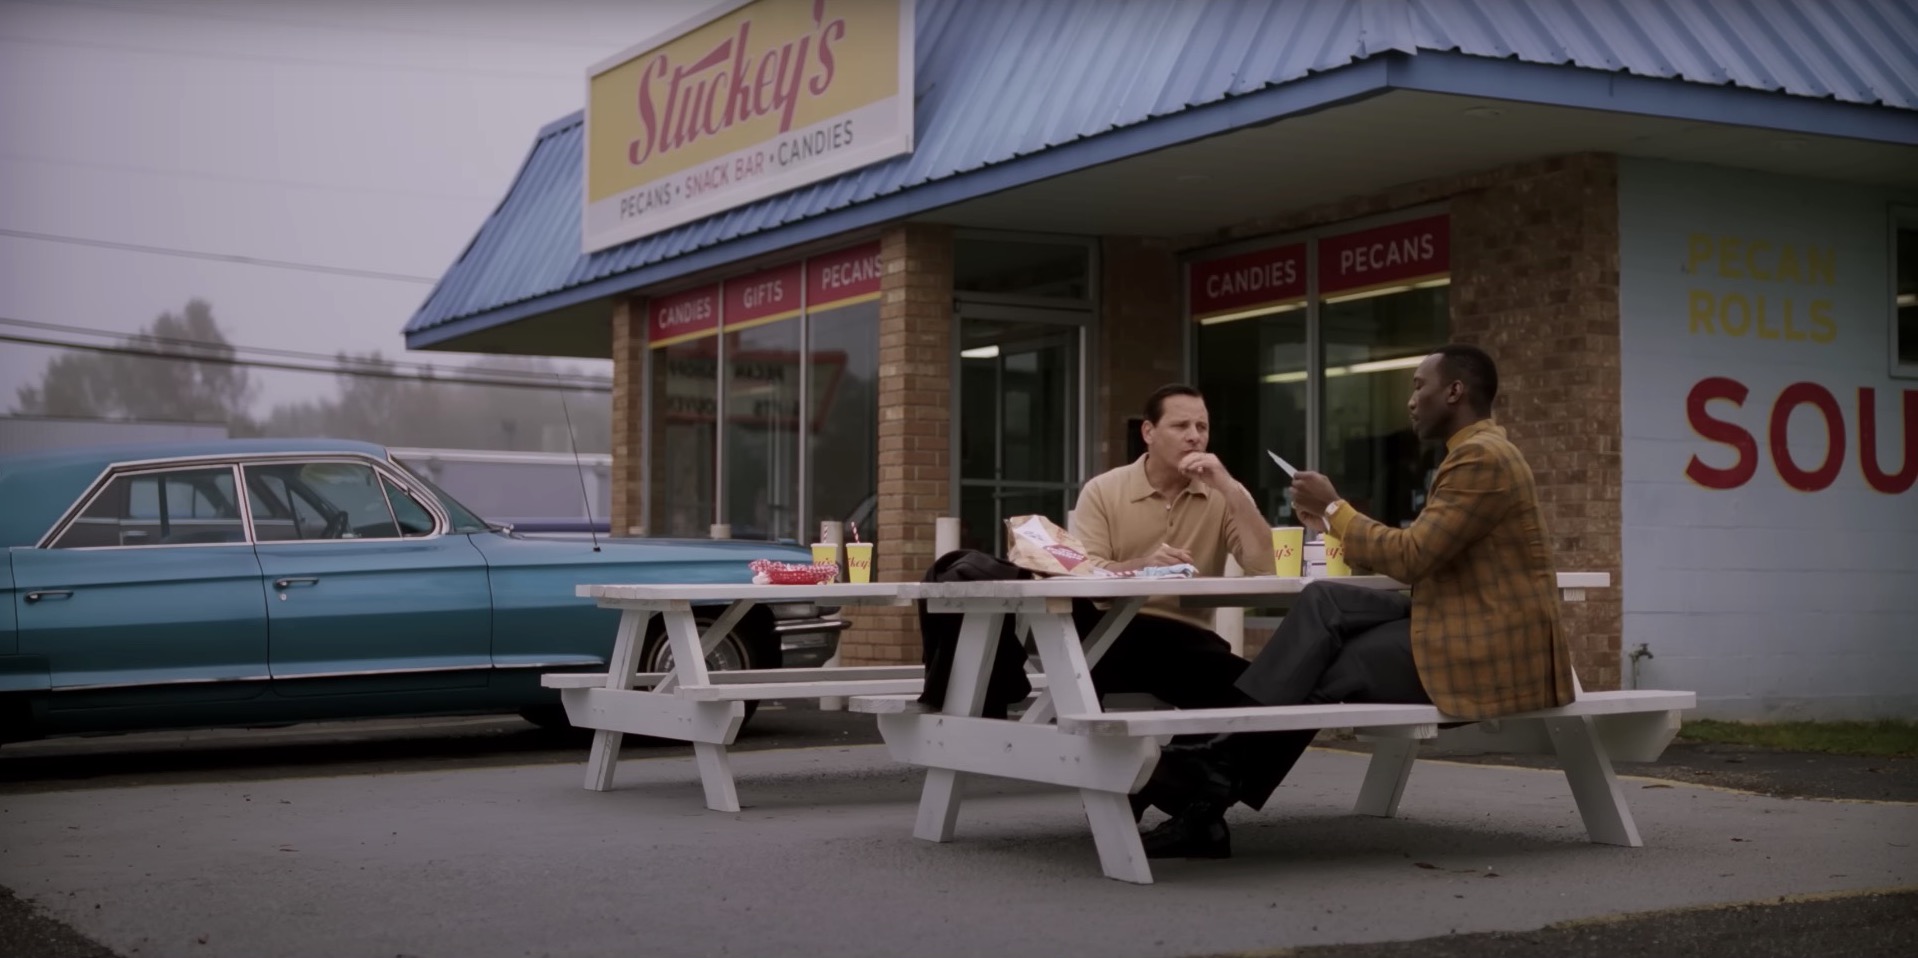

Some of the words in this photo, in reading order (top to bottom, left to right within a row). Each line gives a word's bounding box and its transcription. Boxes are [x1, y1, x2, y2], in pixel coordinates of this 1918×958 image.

[628, 0, 845, 166] Stuckey's
[620, 183, 671, 220] PECANS
[684, 162, 729, 198] SNACK
[734, 151, 764, 181] BAR
[778, 120, 853, 167] CANDIES
[821, 254, 882, 291] PECANS
[1341, 233, 1434, 275] PECANS
[1687, 232, 1838, 287] PECAN
[743, 279, 783, 310] GIFTS
[1206, 259, 1297, 298] CANDIES
[658, 296, 711, 330] CANDIES
[1688, 288, 1837, 345] ROLLS
[1684, 376, 1918, 495] SOU
